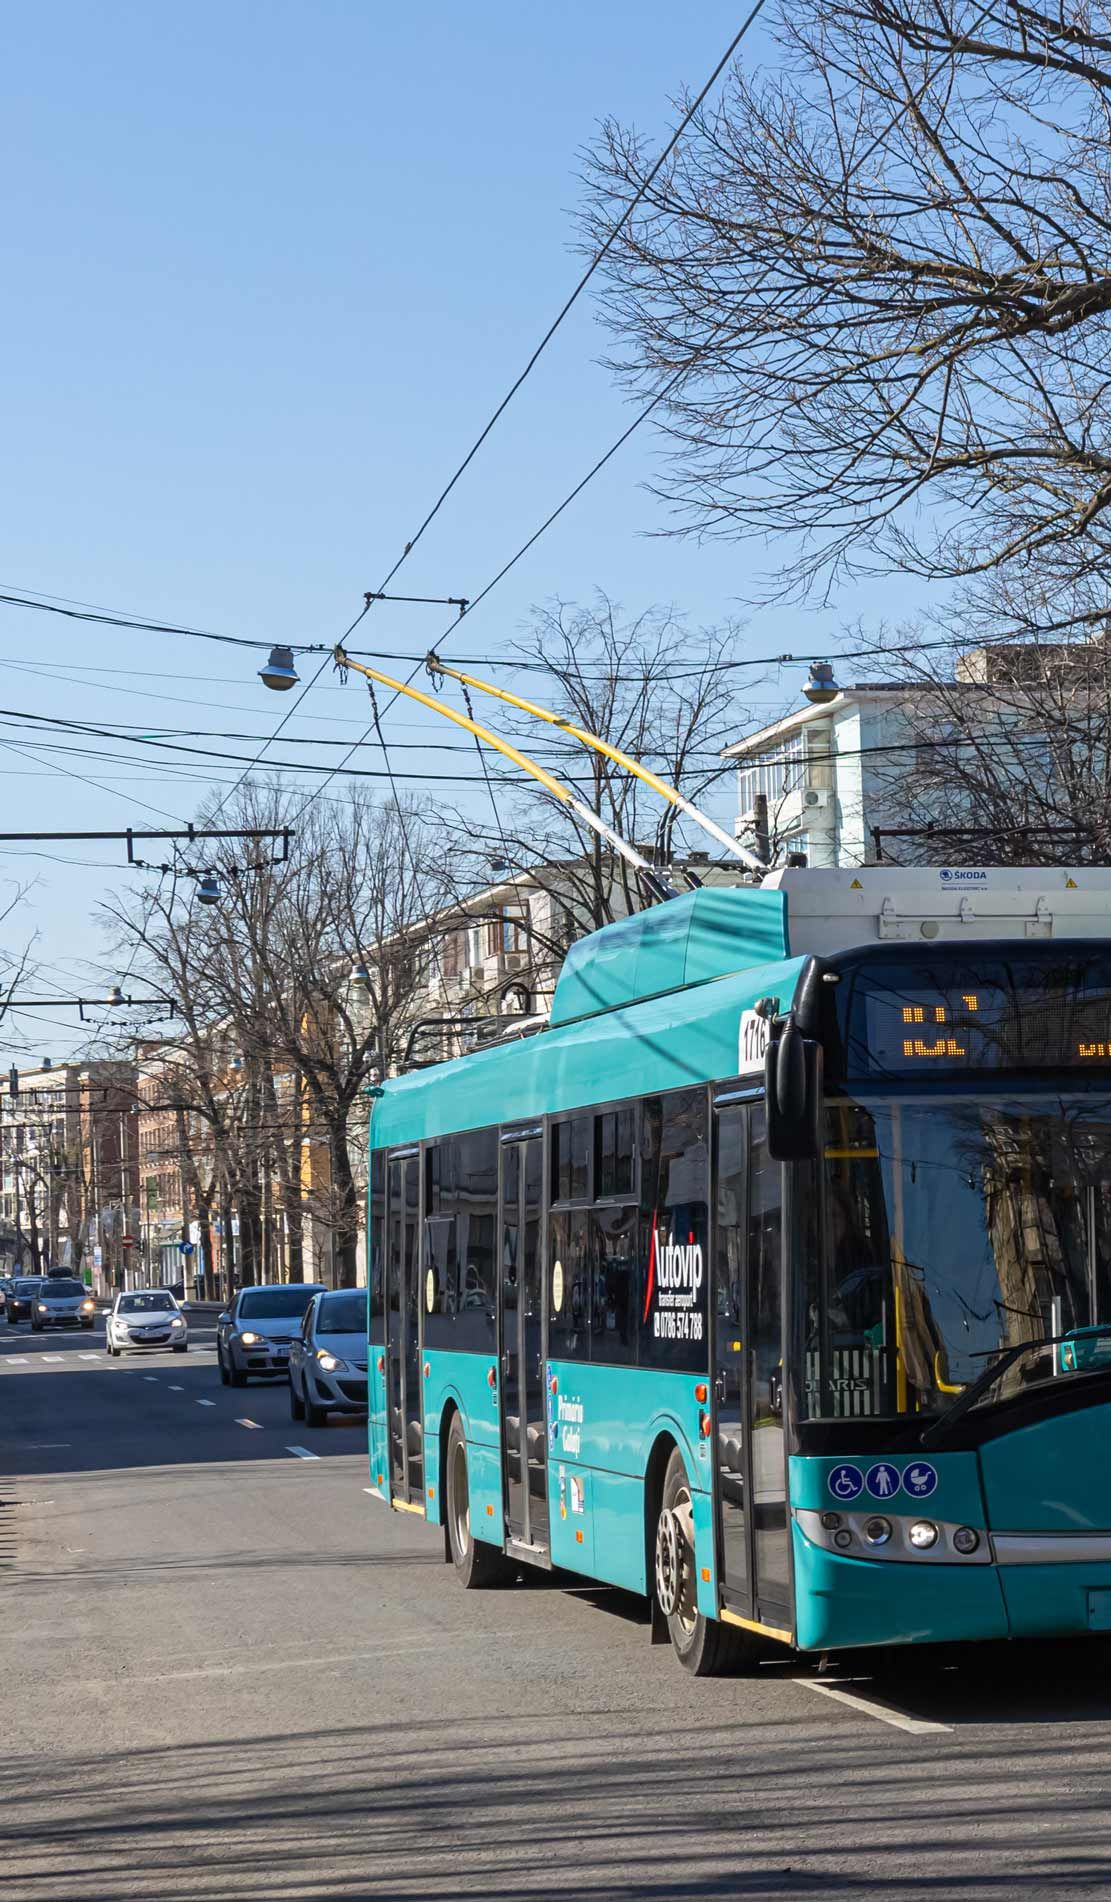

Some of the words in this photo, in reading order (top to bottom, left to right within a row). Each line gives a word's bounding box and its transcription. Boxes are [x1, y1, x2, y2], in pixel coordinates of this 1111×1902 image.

[954, 870, 987, 880] ŠKODA
[744, 1017, 766, 1062] 1716
[677, 1311, 689, 1339] 574
[689, 1311, 703, 1341] 788
